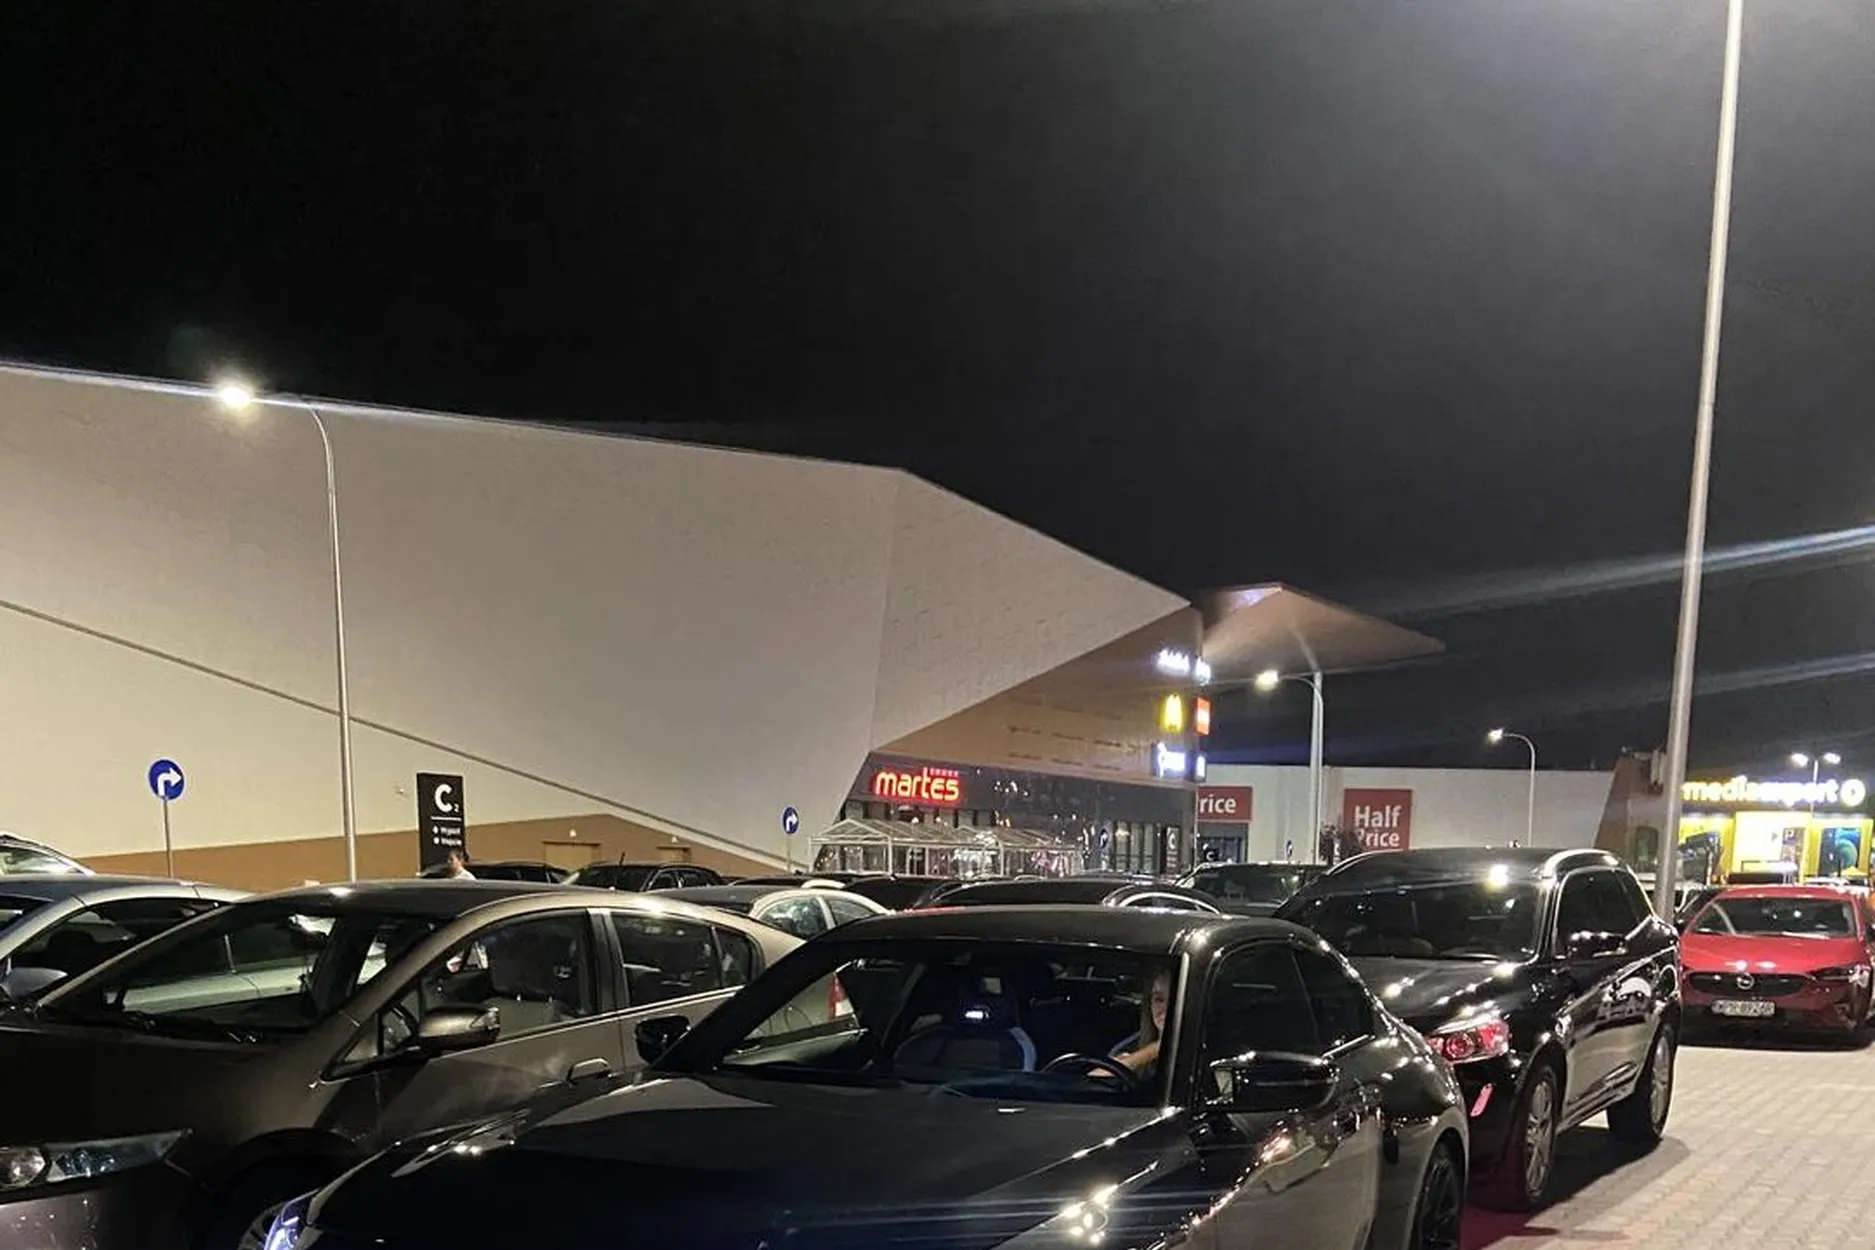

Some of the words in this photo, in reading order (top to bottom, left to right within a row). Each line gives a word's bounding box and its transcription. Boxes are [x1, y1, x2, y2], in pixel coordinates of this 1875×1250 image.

[874, 767, 960, 801] martes
[1199, 794, 1237, 813] rice
[1355, 805, 1402, 828] Half
